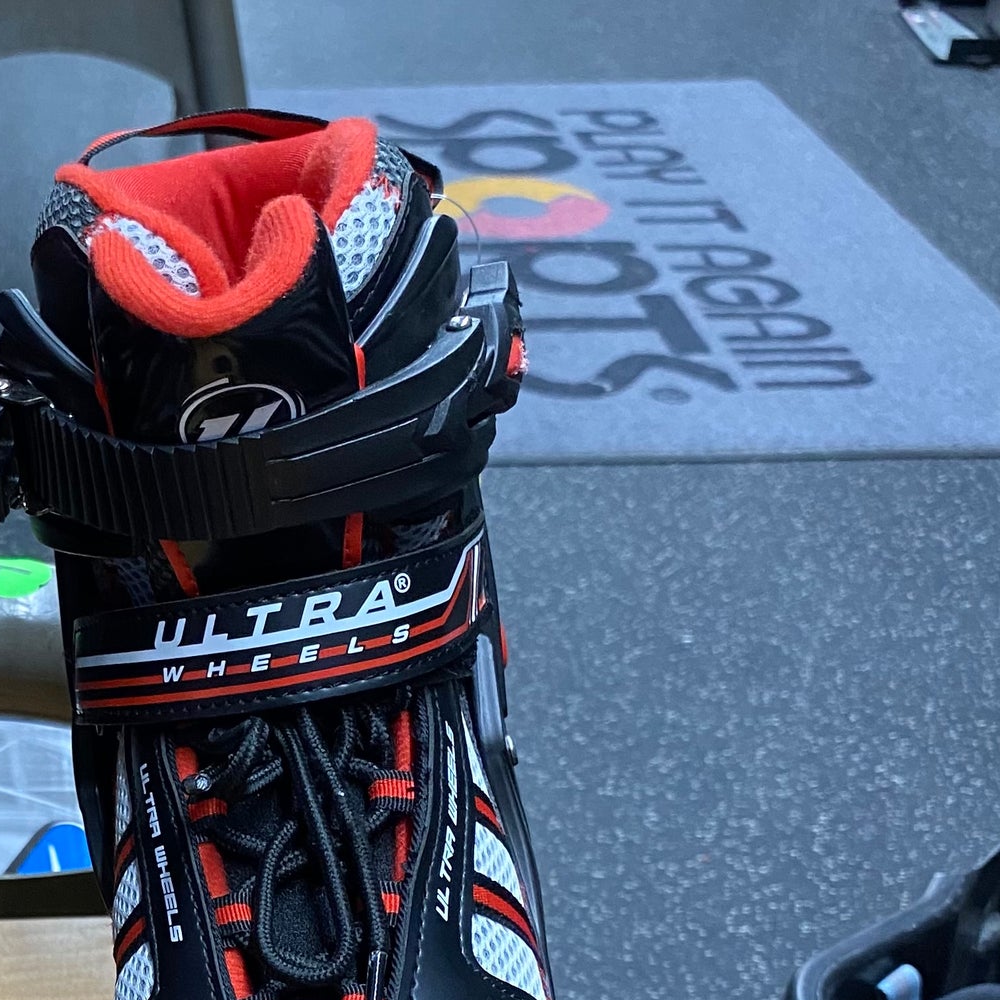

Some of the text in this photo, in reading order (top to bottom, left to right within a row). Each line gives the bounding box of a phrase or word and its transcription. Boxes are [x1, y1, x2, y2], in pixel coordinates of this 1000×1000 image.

[558, 109, 874, 390] PLAY IT AGAIN
[162, 623, 410, 683] WHEELS
[139, 763, 184, 943] ULTRA WHEELS
[436, 720, 458, 922] ULTRA WHEELS
